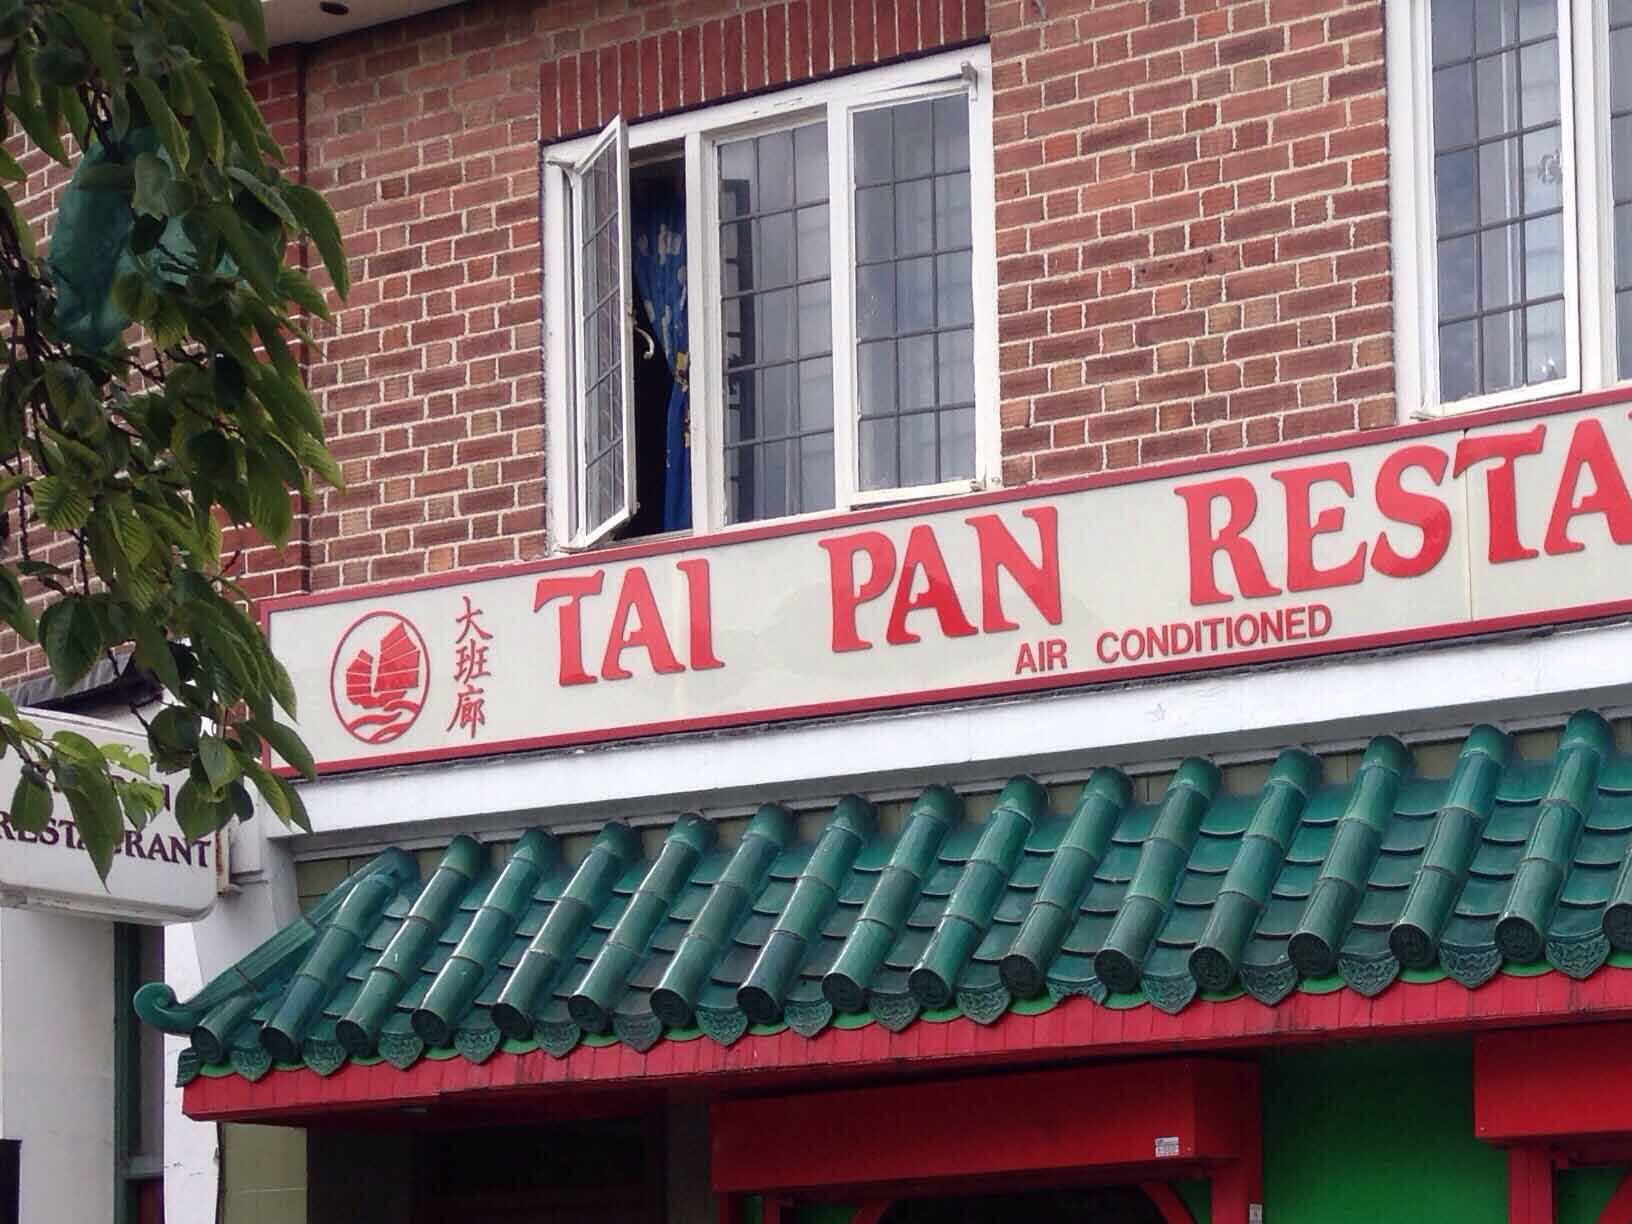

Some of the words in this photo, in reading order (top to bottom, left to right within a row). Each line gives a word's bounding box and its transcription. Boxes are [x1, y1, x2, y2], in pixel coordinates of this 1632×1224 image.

[533, 557, 725, 687] TAI
[818, 506, 1063, 654] PAN
[1015, 637, 1068, 675] AIR
[1096, 604, 1333, 664] CONDITIONED
[0, 811, 211, 868] RSTRANT
